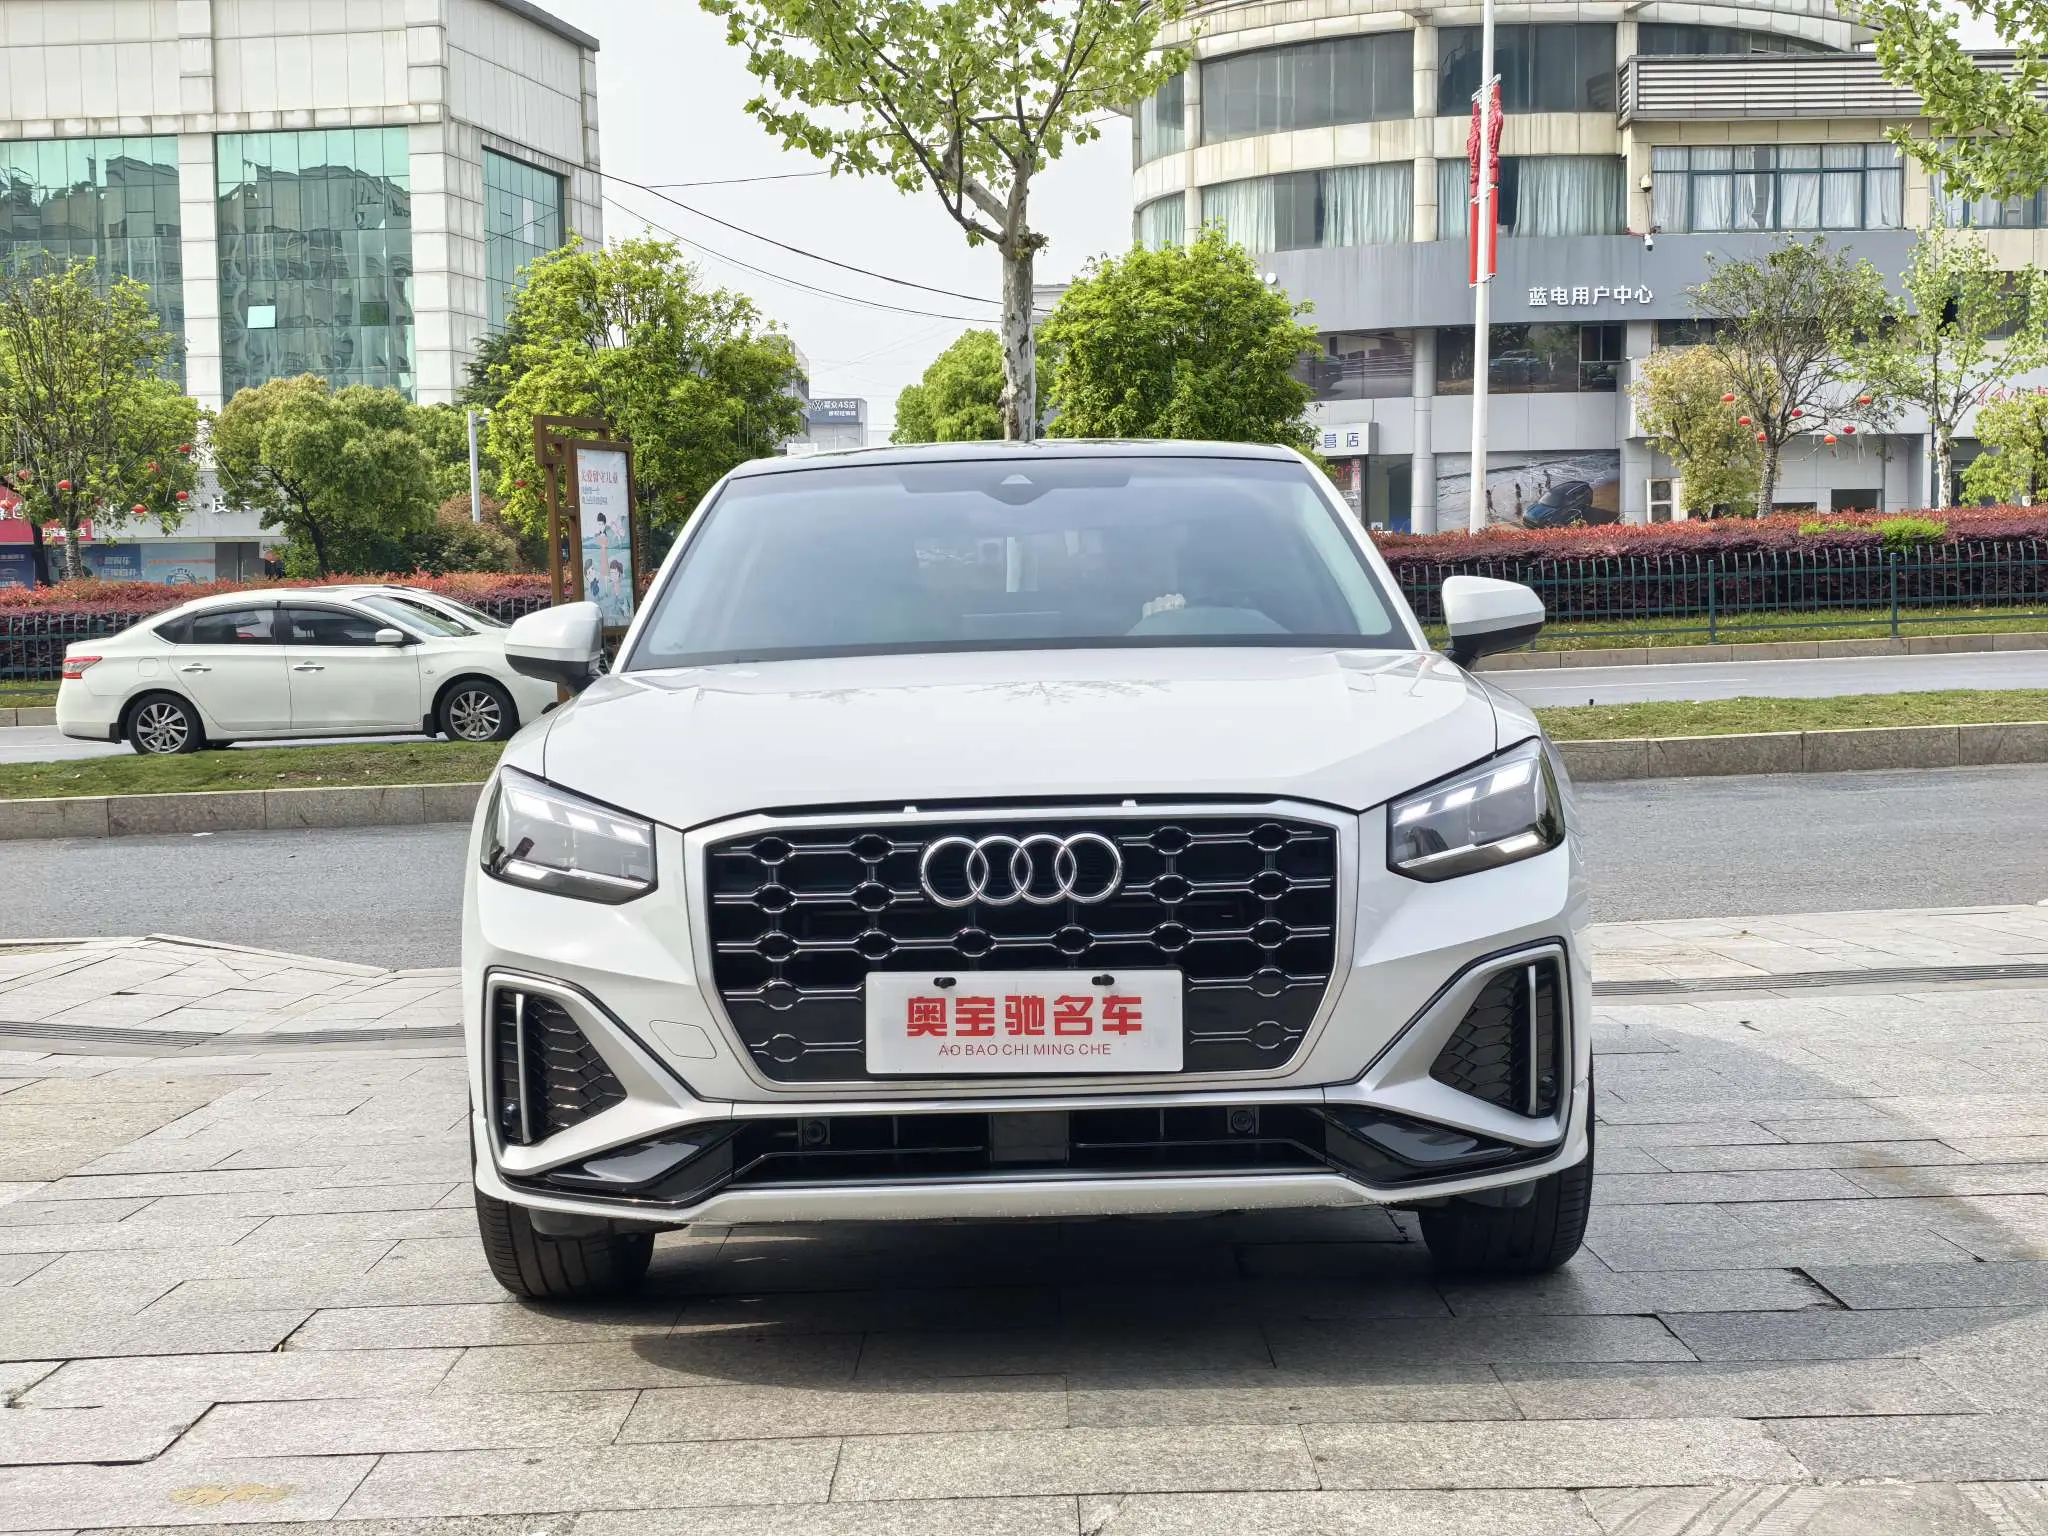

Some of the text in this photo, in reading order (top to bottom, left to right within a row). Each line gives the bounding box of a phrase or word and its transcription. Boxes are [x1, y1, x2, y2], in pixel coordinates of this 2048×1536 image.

[1528, 285, 1654, 306] 蓝电用户中心
[907, 995, 1142, 1037] 奥宝驰名车
[938, 1043, 1112, 1056] AO BAO CHI MING CHE
